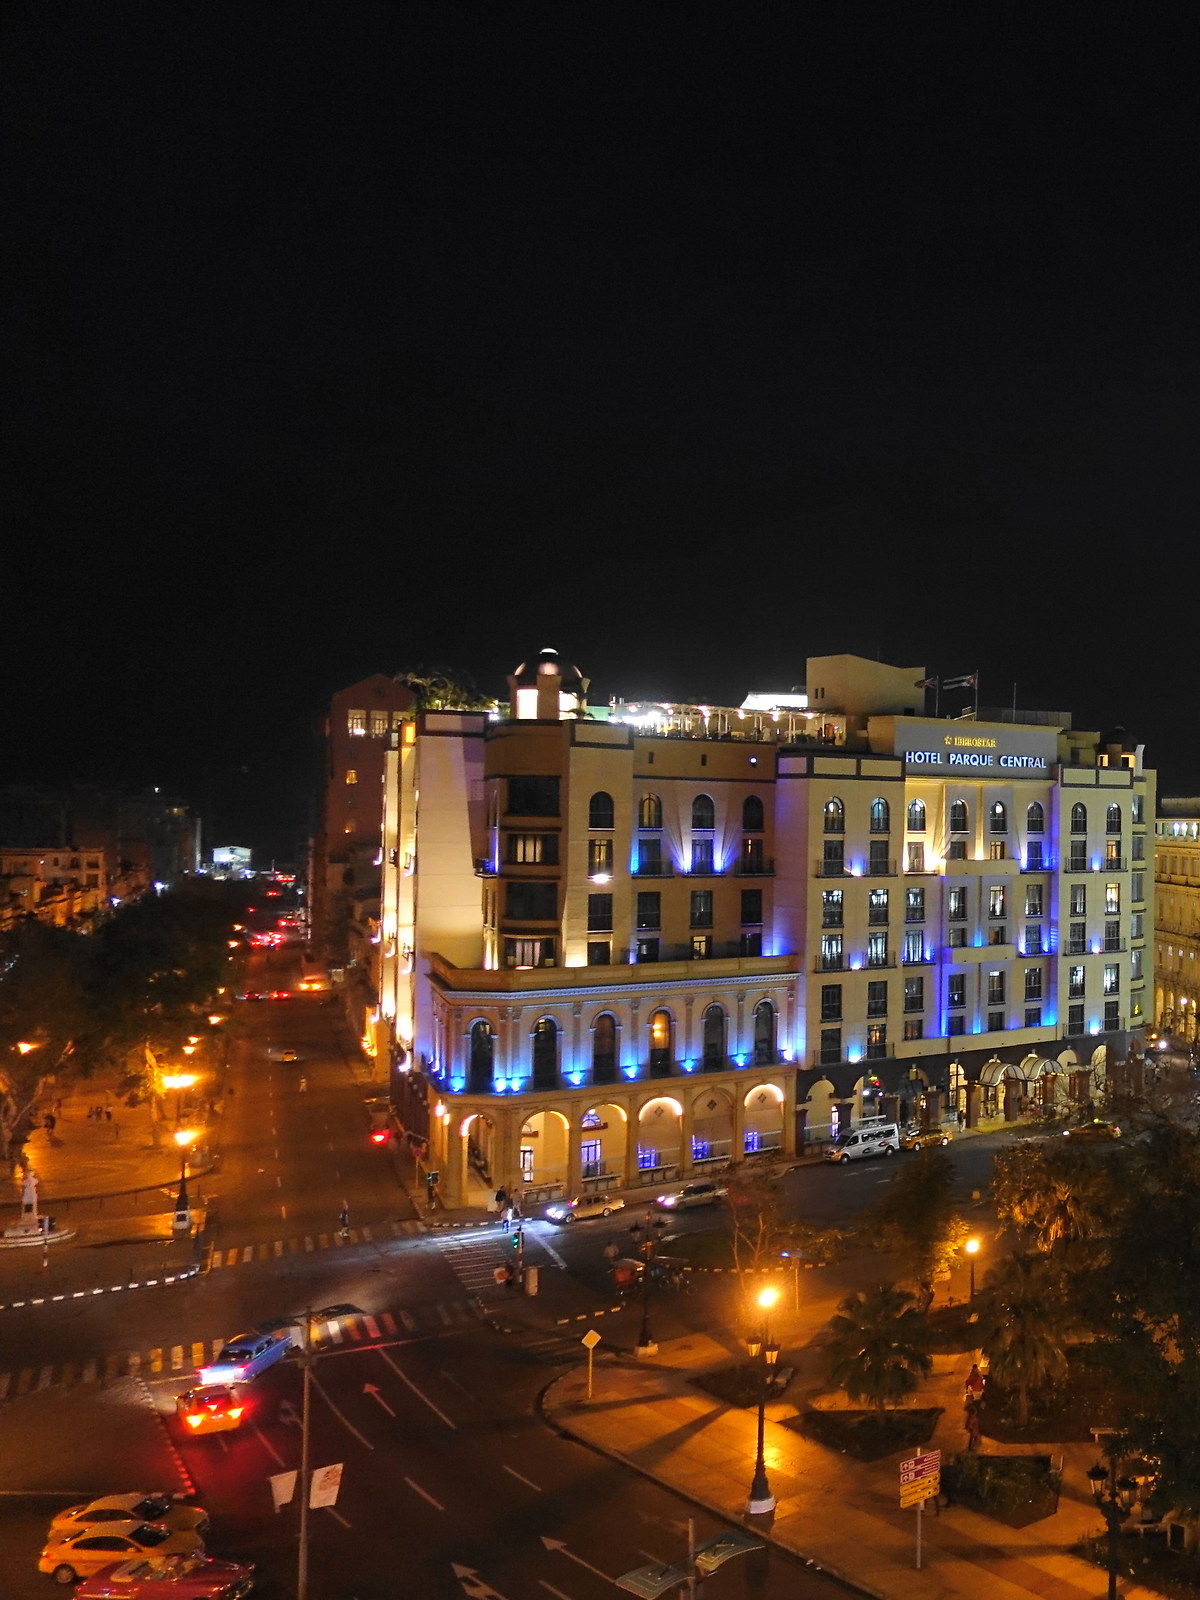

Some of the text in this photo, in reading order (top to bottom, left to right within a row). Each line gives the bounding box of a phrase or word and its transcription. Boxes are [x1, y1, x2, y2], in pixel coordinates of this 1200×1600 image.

[905, 751, 1047, 769] HOTEL PARQUE CENTRAL
